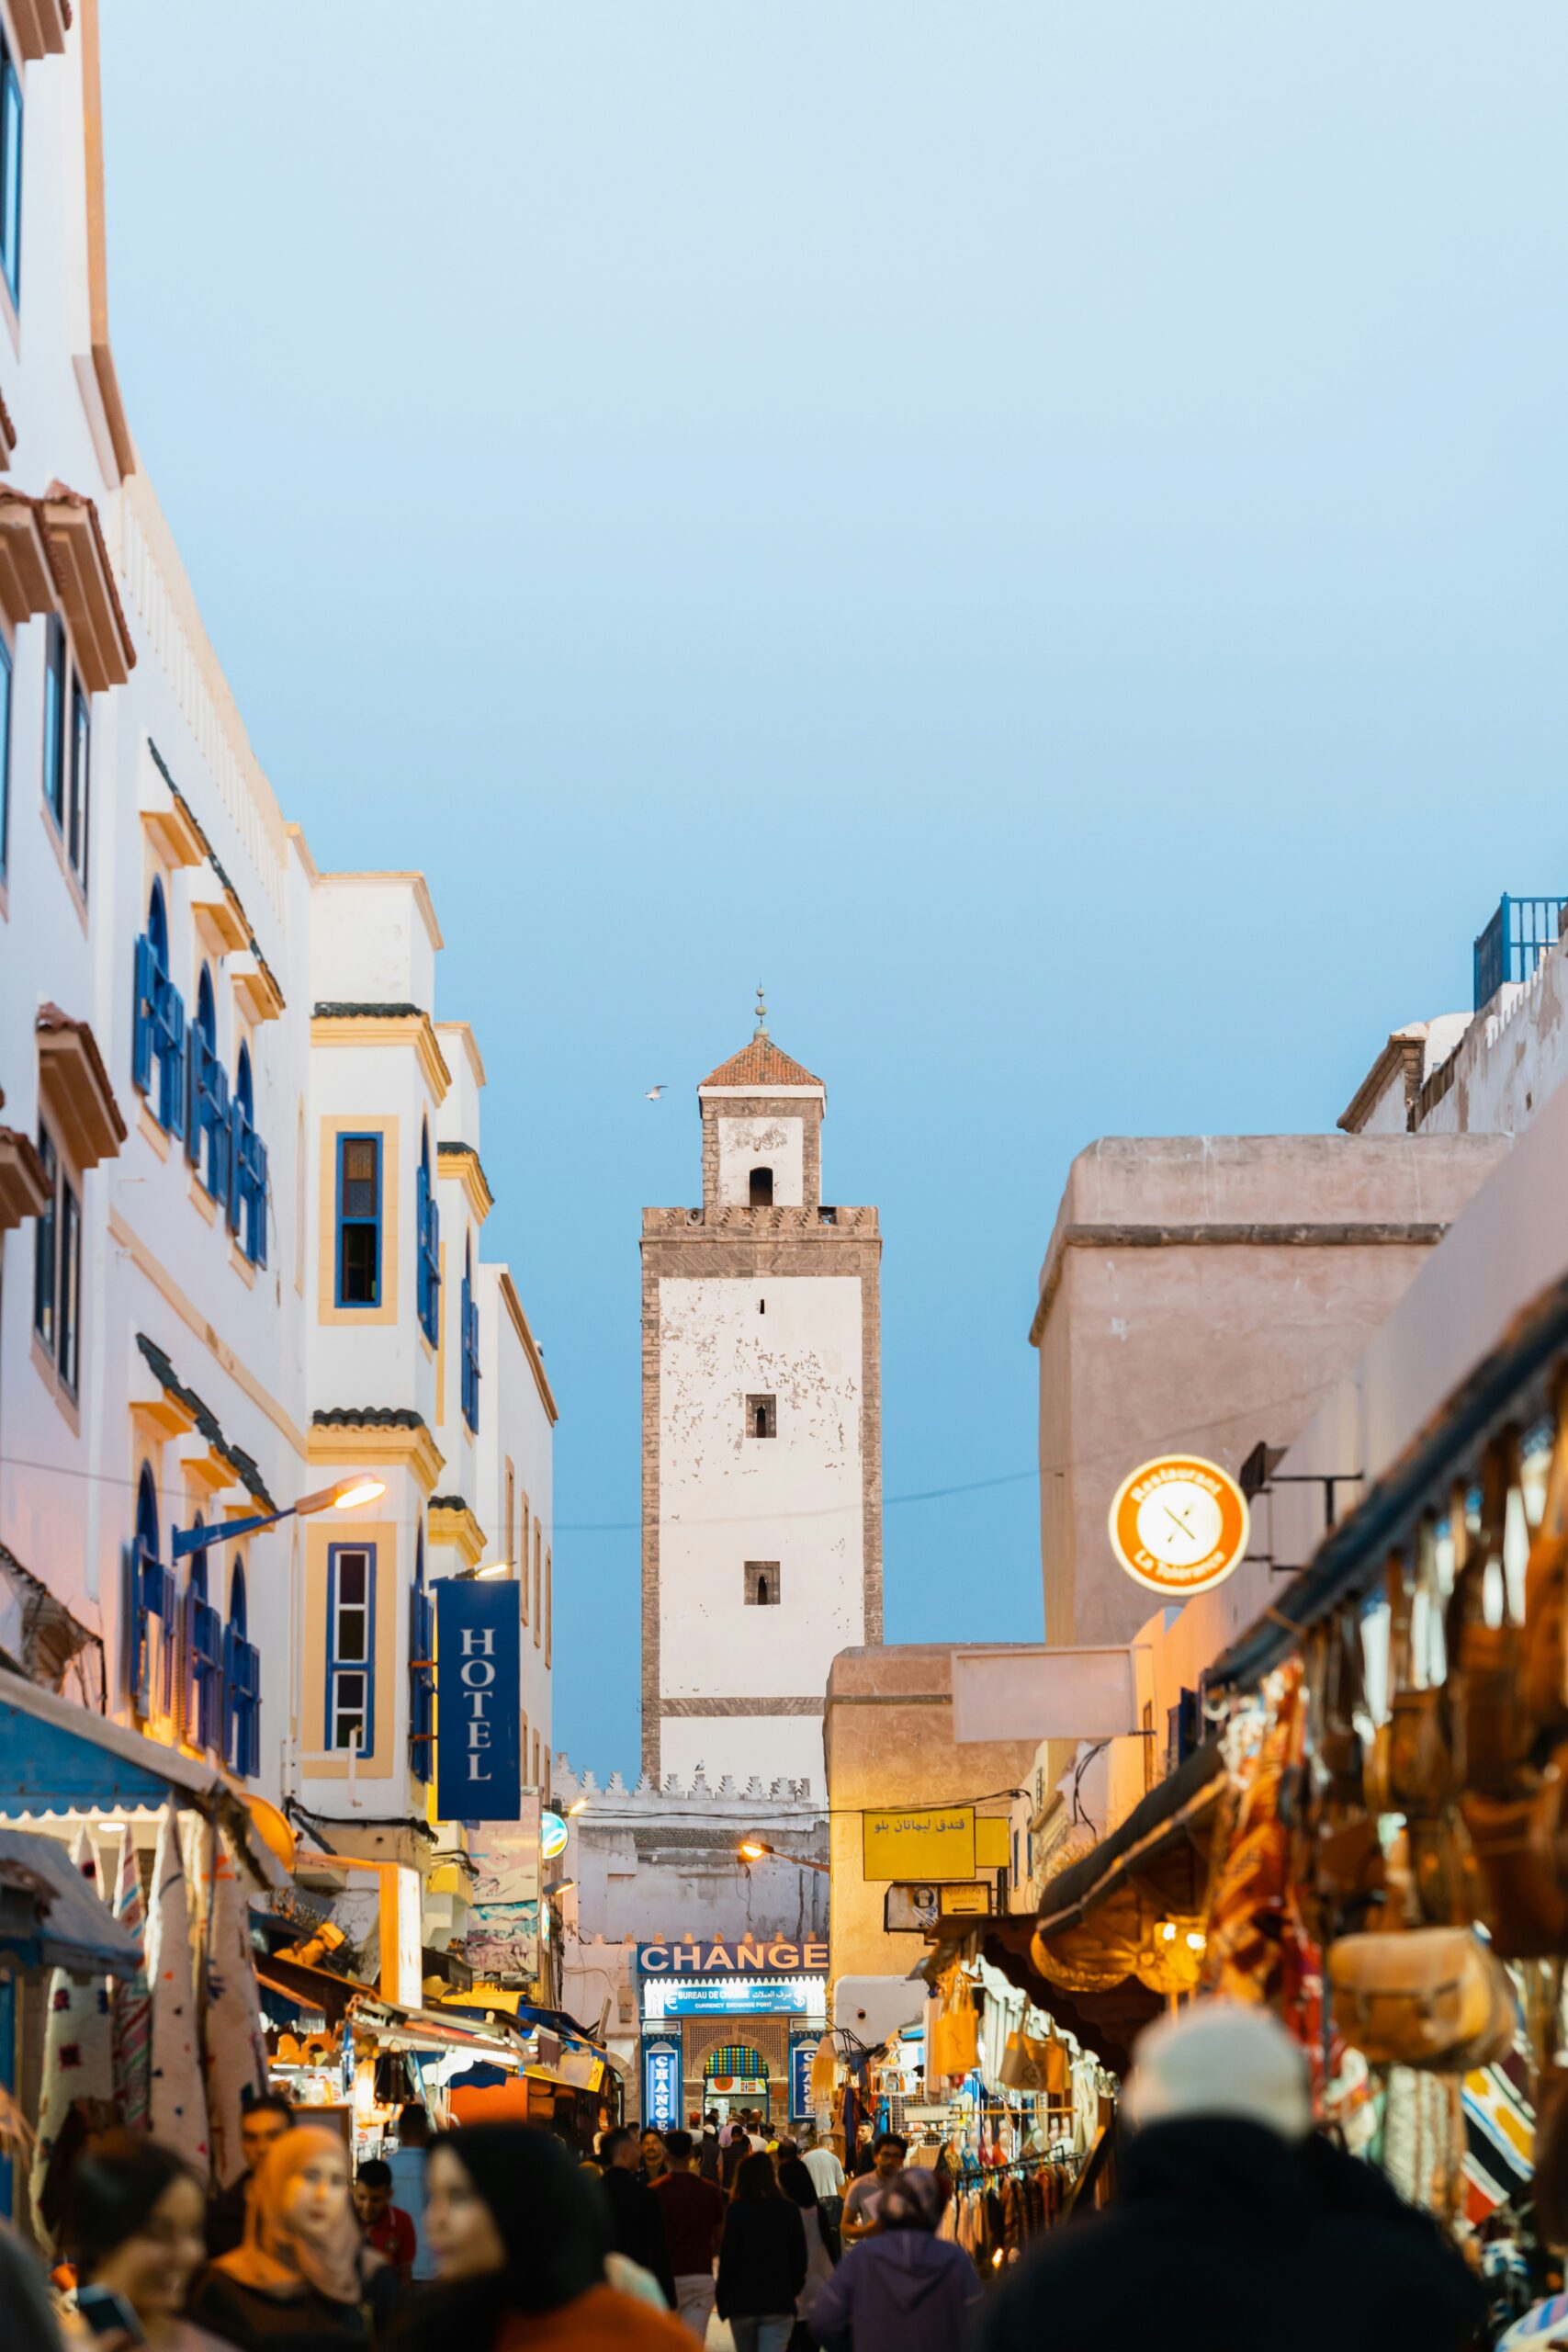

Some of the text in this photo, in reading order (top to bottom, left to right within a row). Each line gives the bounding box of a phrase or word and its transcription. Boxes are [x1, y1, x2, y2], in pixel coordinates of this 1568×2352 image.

[459, 1628, 496, 1781] HOTEL
[935, 1818, 964, 1833] فندق
[640, 1944, 829, 1971] CHANGE
[678, 1991, 707, 1999] BUREAU
[708, 1991, 718, 1999] DE
[655, 2055, 669, 2132] CHANGE
